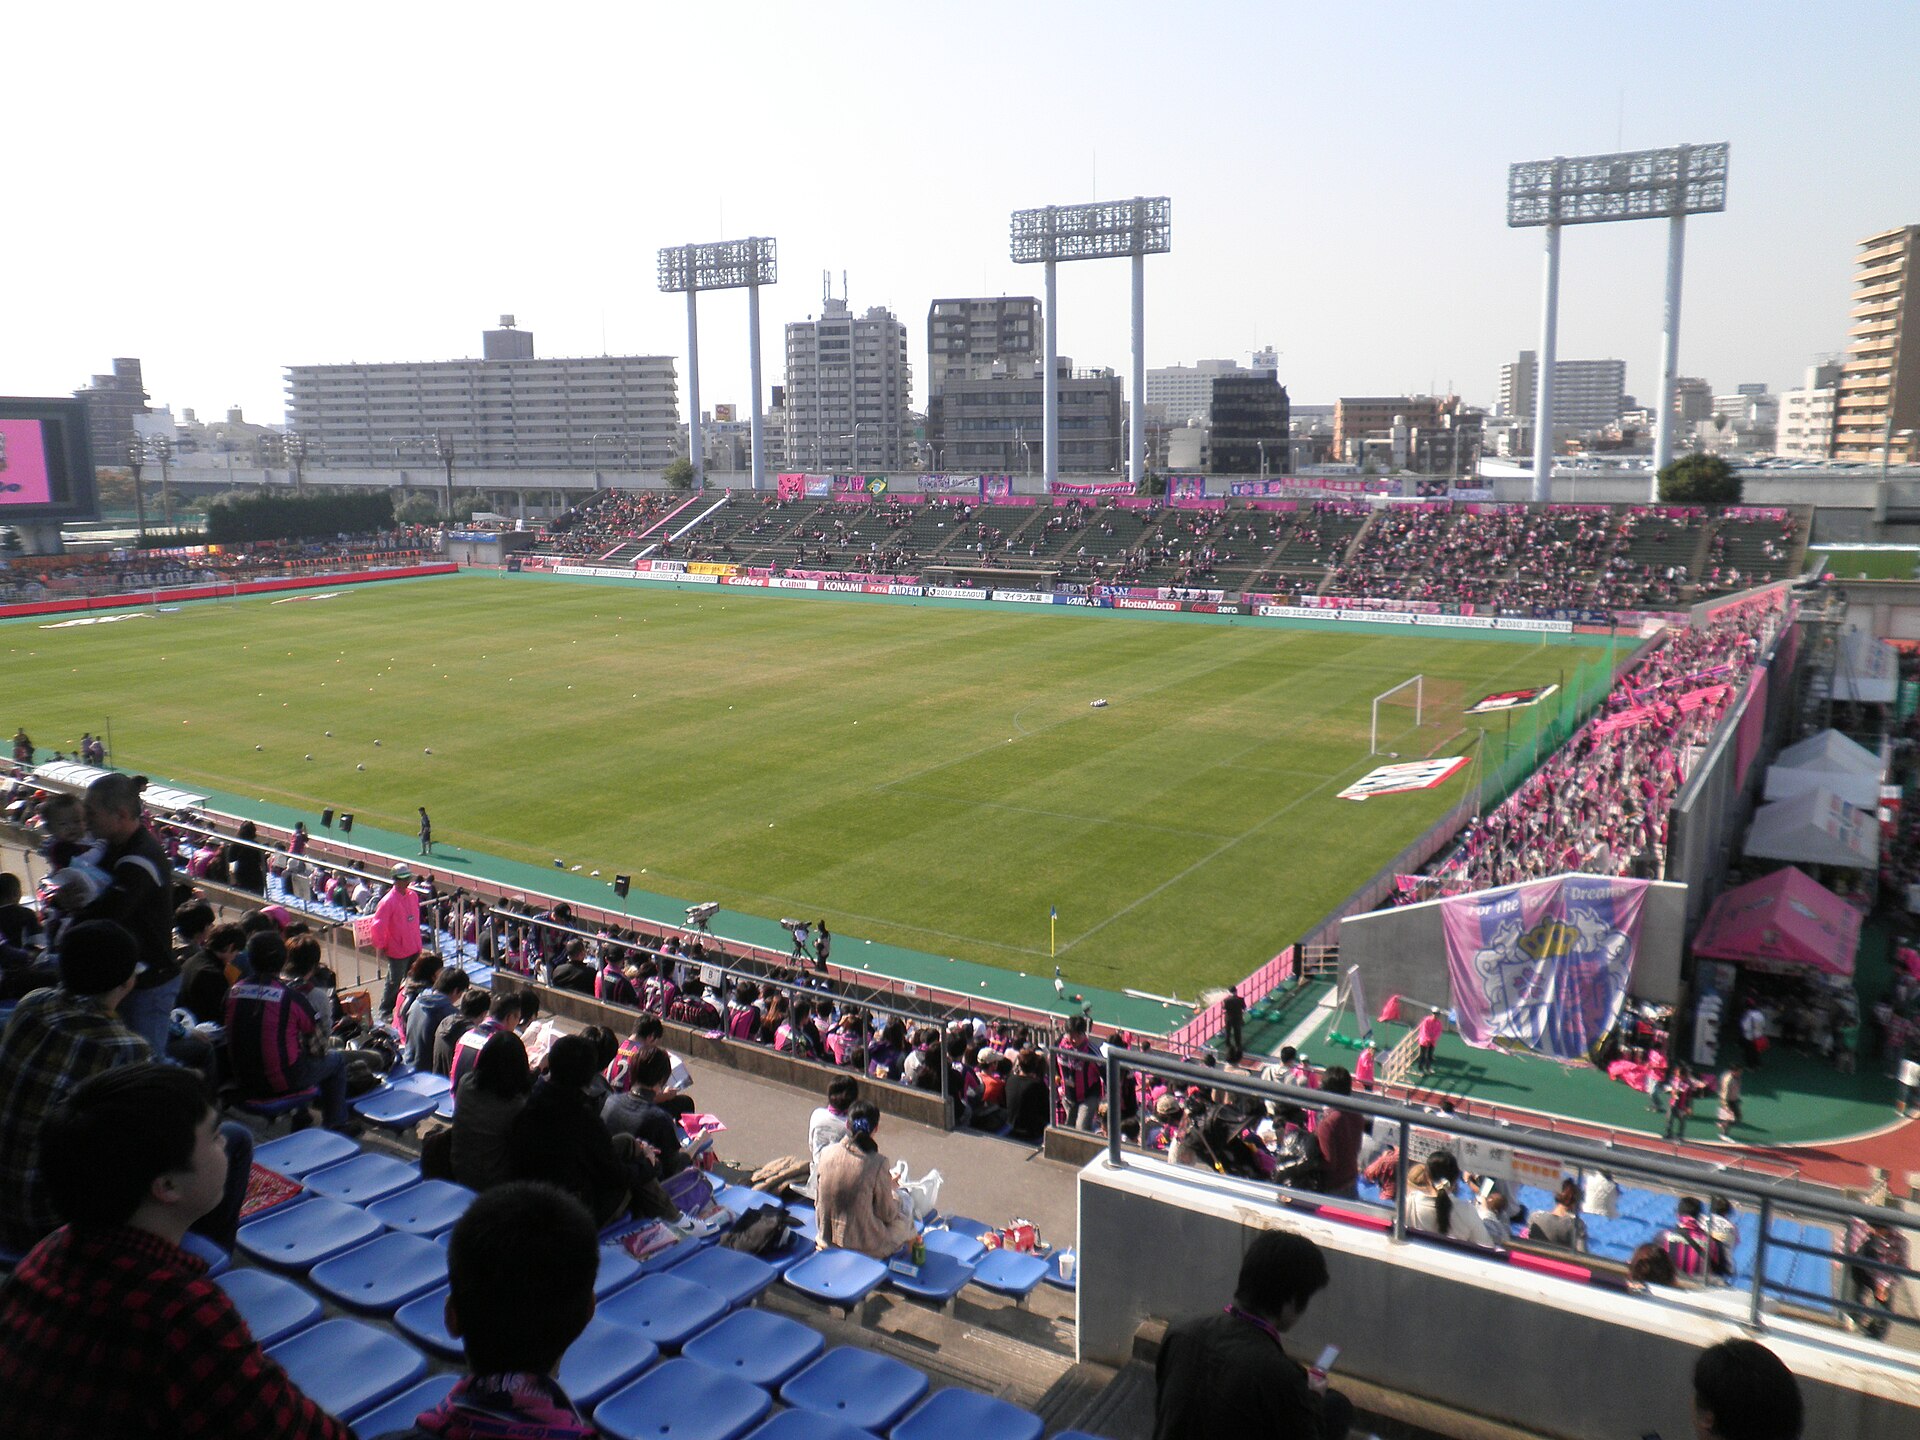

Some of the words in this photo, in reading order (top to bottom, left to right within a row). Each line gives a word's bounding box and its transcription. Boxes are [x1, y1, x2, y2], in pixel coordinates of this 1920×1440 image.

[728, 576, 764, 586] Calbee
[780, 580, 808, 588] Canon
[824, 582, 862, 592] KONAMI
[1004, 593, 1042, 601] マイラン製薬
[1572, 887, 1627, 901] Dreams
